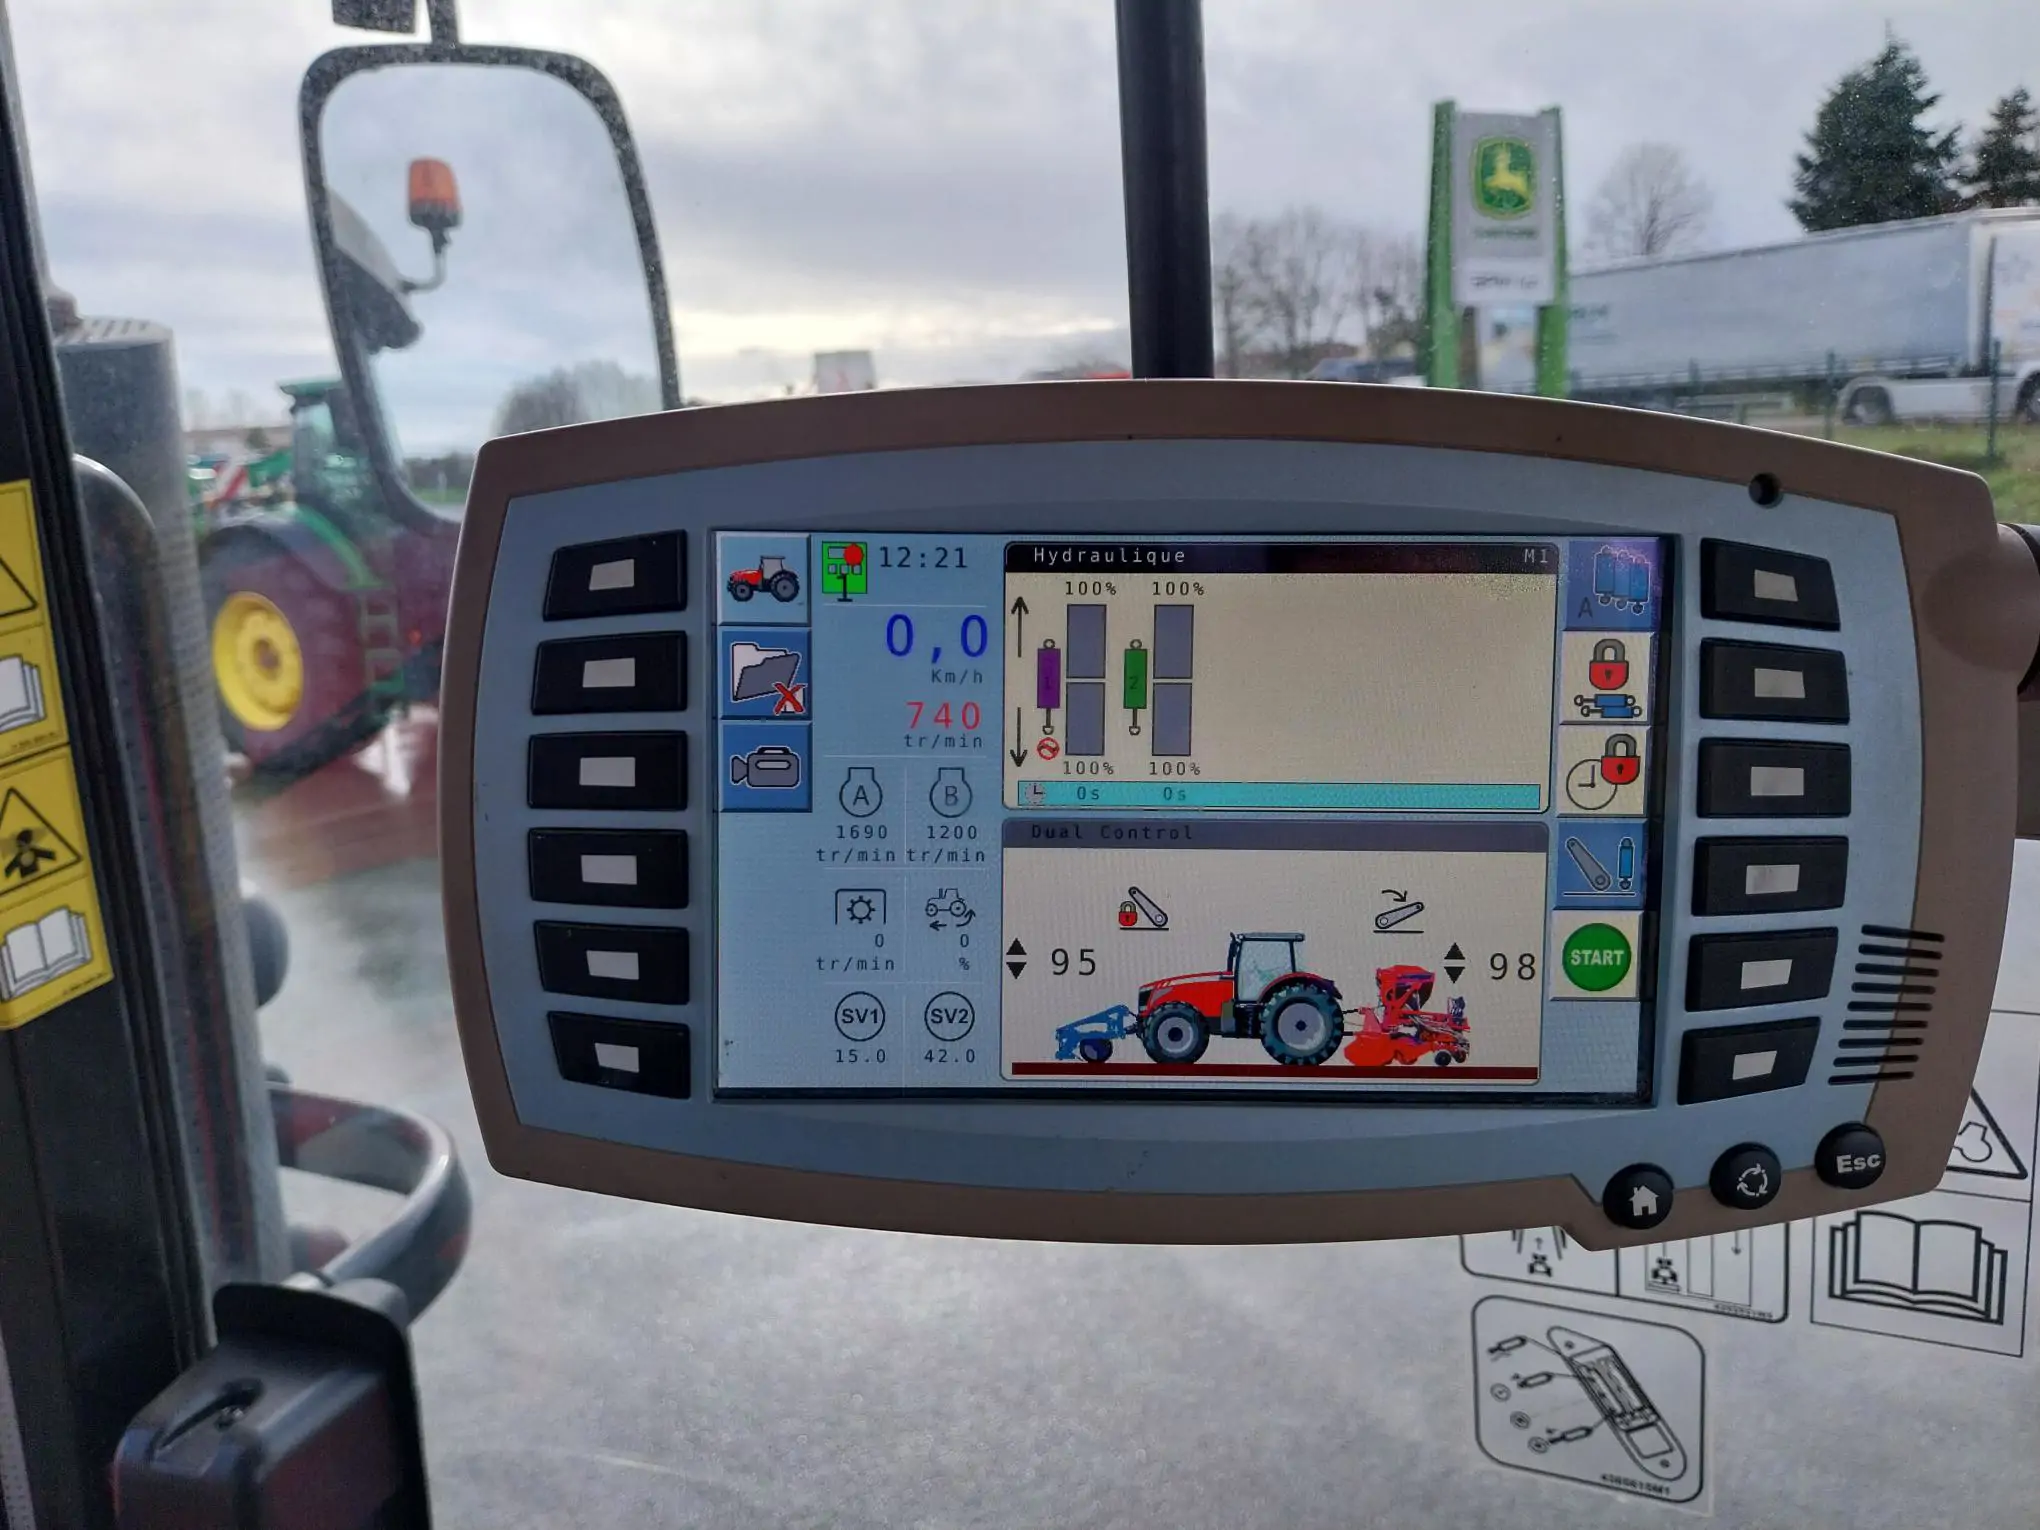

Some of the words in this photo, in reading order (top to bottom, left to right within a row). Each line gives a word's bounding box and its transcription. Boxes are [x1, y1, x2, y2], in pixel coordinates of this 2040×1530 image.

[880, 546, 968, 568] 12:21
[1034, 547, 1186, 566] Hydraulique
[1065, 581, 1117, 596] 100%
[1152, 581, 1204, 597] 100%
[1578, 597, 1594, 618] A
[886, 613, 988, 664] 0,0
[931, 668, 983, 685] Km/h
[906, 701, 981, 730] 740
[904, 733, 983, 749] tr/min
[1063, 761, 1114, 775] 100%
[1149, 761, 1201, 776] 100%
[852, 785, 870, 806] A
[944, 785, 959, 807] B
[1077, 786, 1100, 801] 0s
[1163, 787, 1187, 801] 0s
[836, 824, 888, 839] 1690
[926, 825, 978, 840] 1200
[1032, 824, 1083, 840] Dual
[1100, 825, 1193, 841] Control
[815, 848, 896, 863] tr/min
[906, 848, 986, 863] tr/min
[874, 933, 885, 948] 0
[959, 933, 970, 948] 0
[816, 956, 895, 971] tr/min
[958, 957, 970, 971] %
[1051, 948, 1096, 976] 95
[1489, 952, 1535, 980] 98
[1570, 949, 1624, 967] START
[841, 1008, 878, 1024] SV1
[930, 1008, 969, 1024] SV2
[835, 1048, 886, 1063] 15.0
[924, 1049, 975, 1064] 42.0
[1836, 1153, 1881, 1174] Esc
